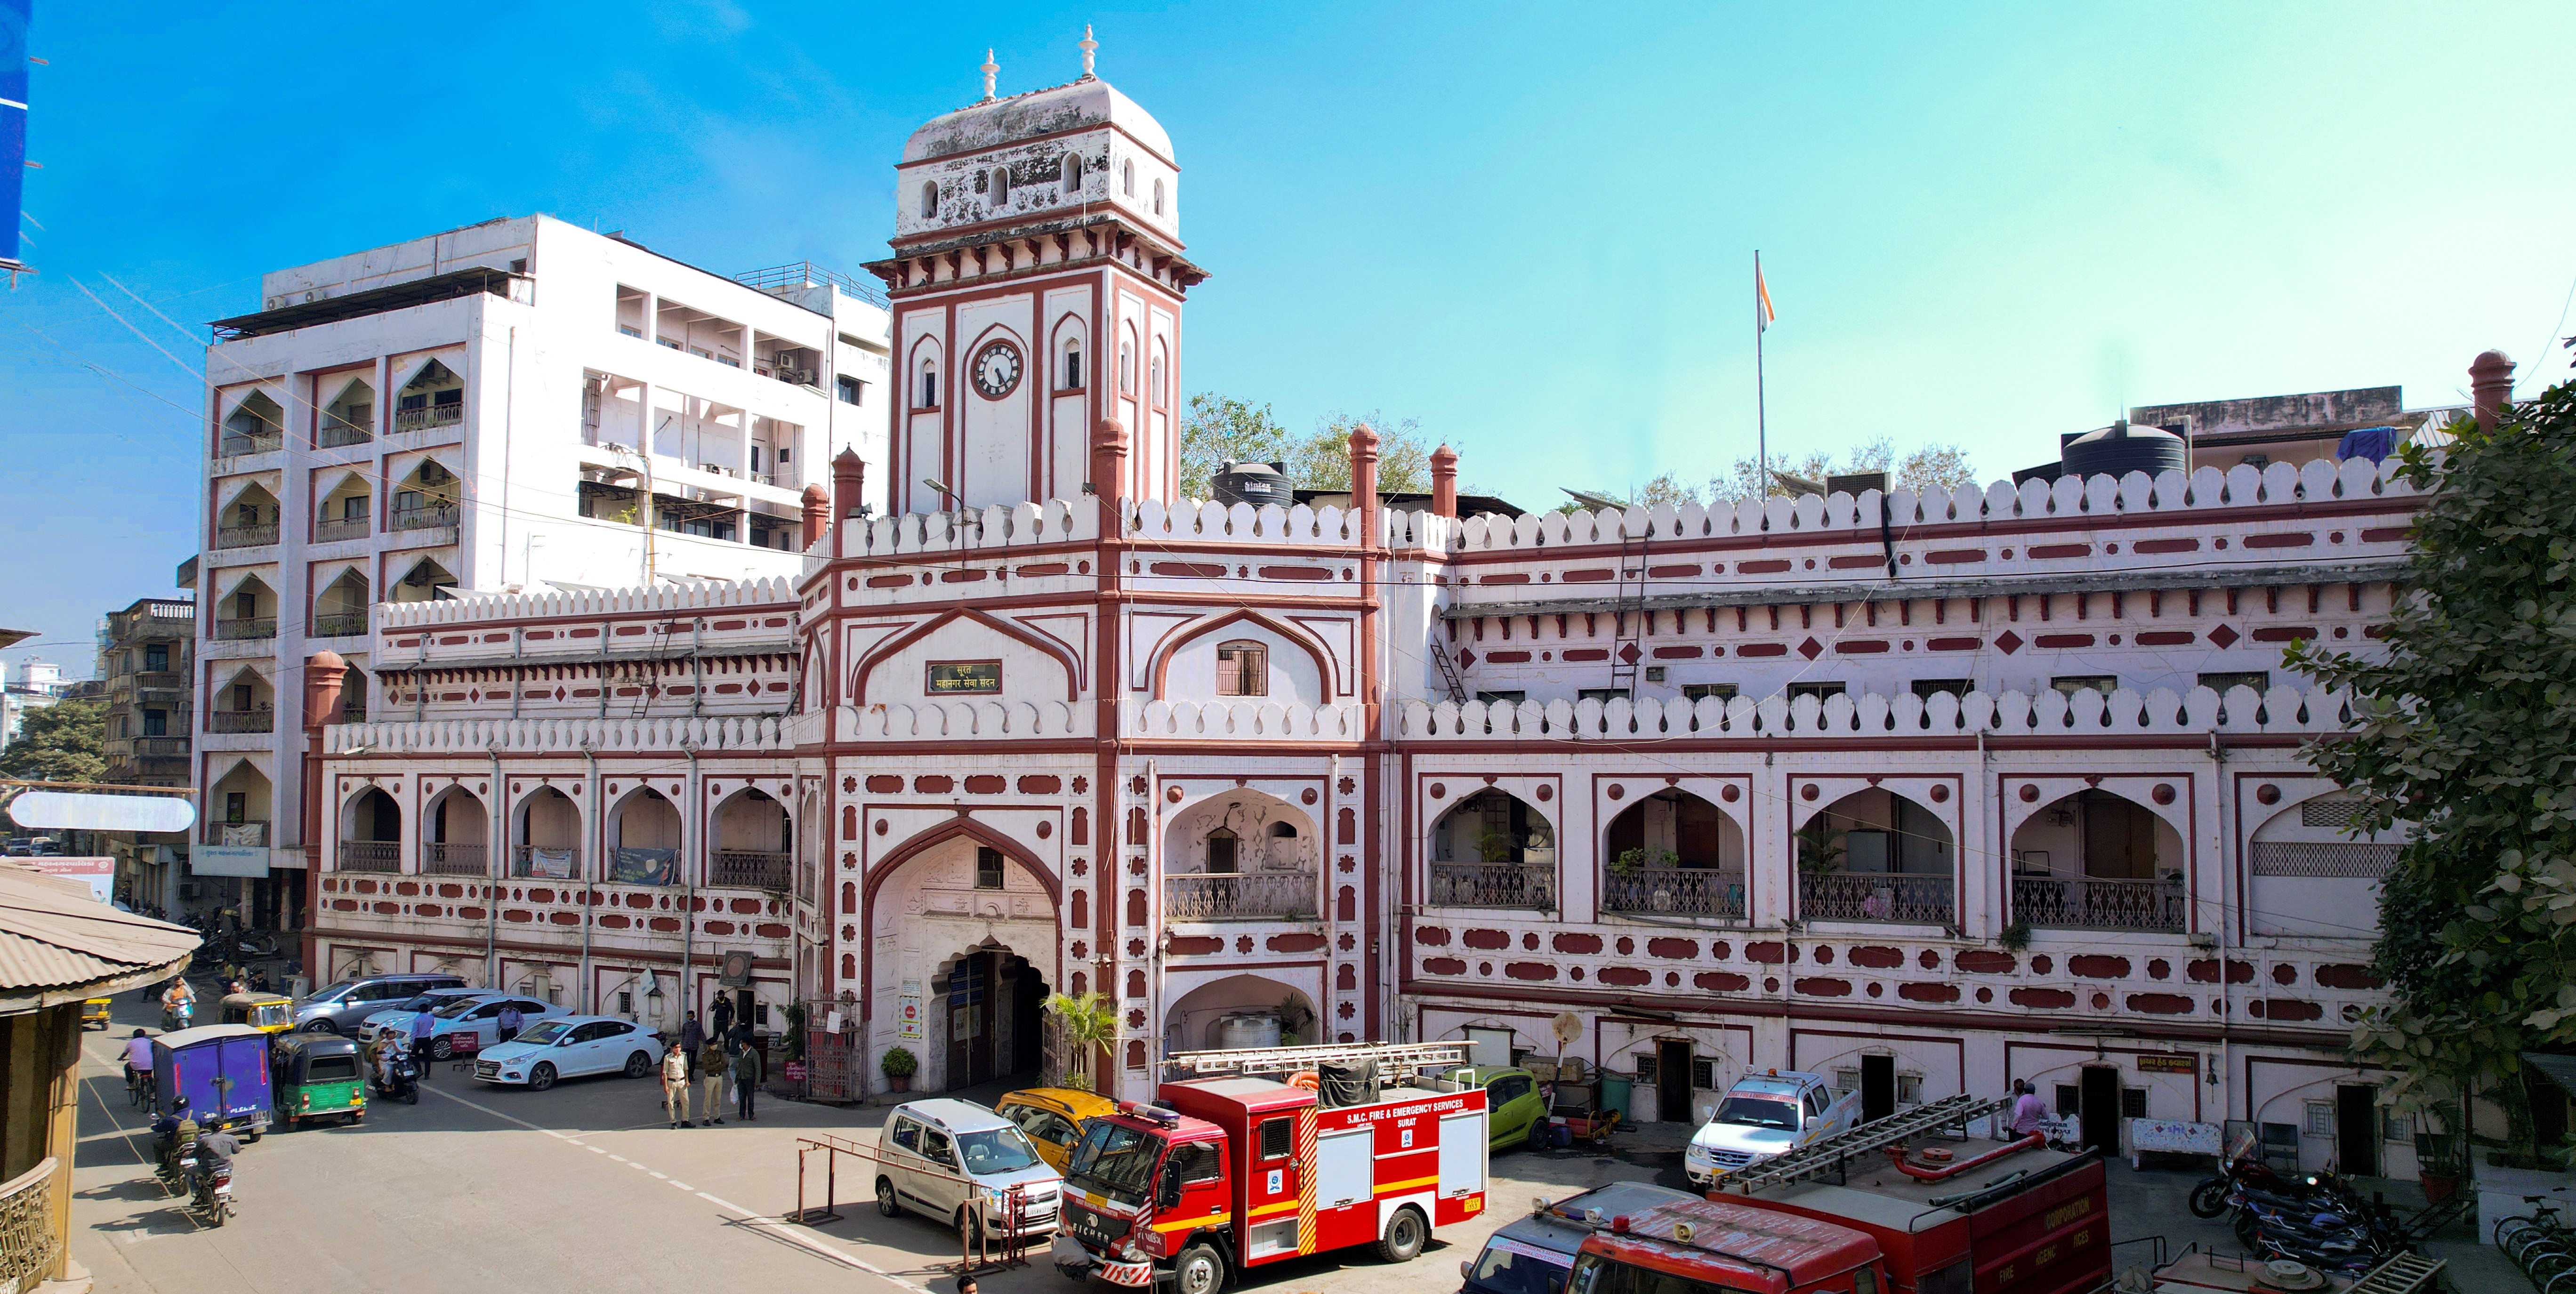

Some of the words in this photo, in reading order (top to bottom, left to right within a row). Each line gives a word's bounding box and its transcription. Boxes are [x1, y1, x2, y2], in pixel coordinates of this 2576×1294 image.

[957, 666, 972, 676] सूरत
[936, 679, 961, 688] महानगर
[963, 676, 977, 688] सेवा
[979, 679, 995, 687] सदन
[1347, 1112, 1368, 1124] S.M.C.
[1369, 1110, 1385, 1121] FIRE
[1386, 1109, 1391, 1118] &
[1393, 1103, 1432, 1117] EMERGENCY
[1433, 1099, 1463, 1112] SERVICES
[1398, 1117, 1417, 1128] SURAT
[1098, 1206, 1118, 1217] CORPORATION
[2045, 1197, 2089, 1231] CORPORATION
[1073, 1222, 1109, 1244] EICHER
[1111, 1242, 1121, 1251] FIRE
[1520, 1244, 1545, 1253] EMERGENCY
[1546, 1250, 1567, 1260] SERVICES
[1554, 1258, 1572, 1268] GUJARA
[1999, 1264, 2014, 1284] FIRE
